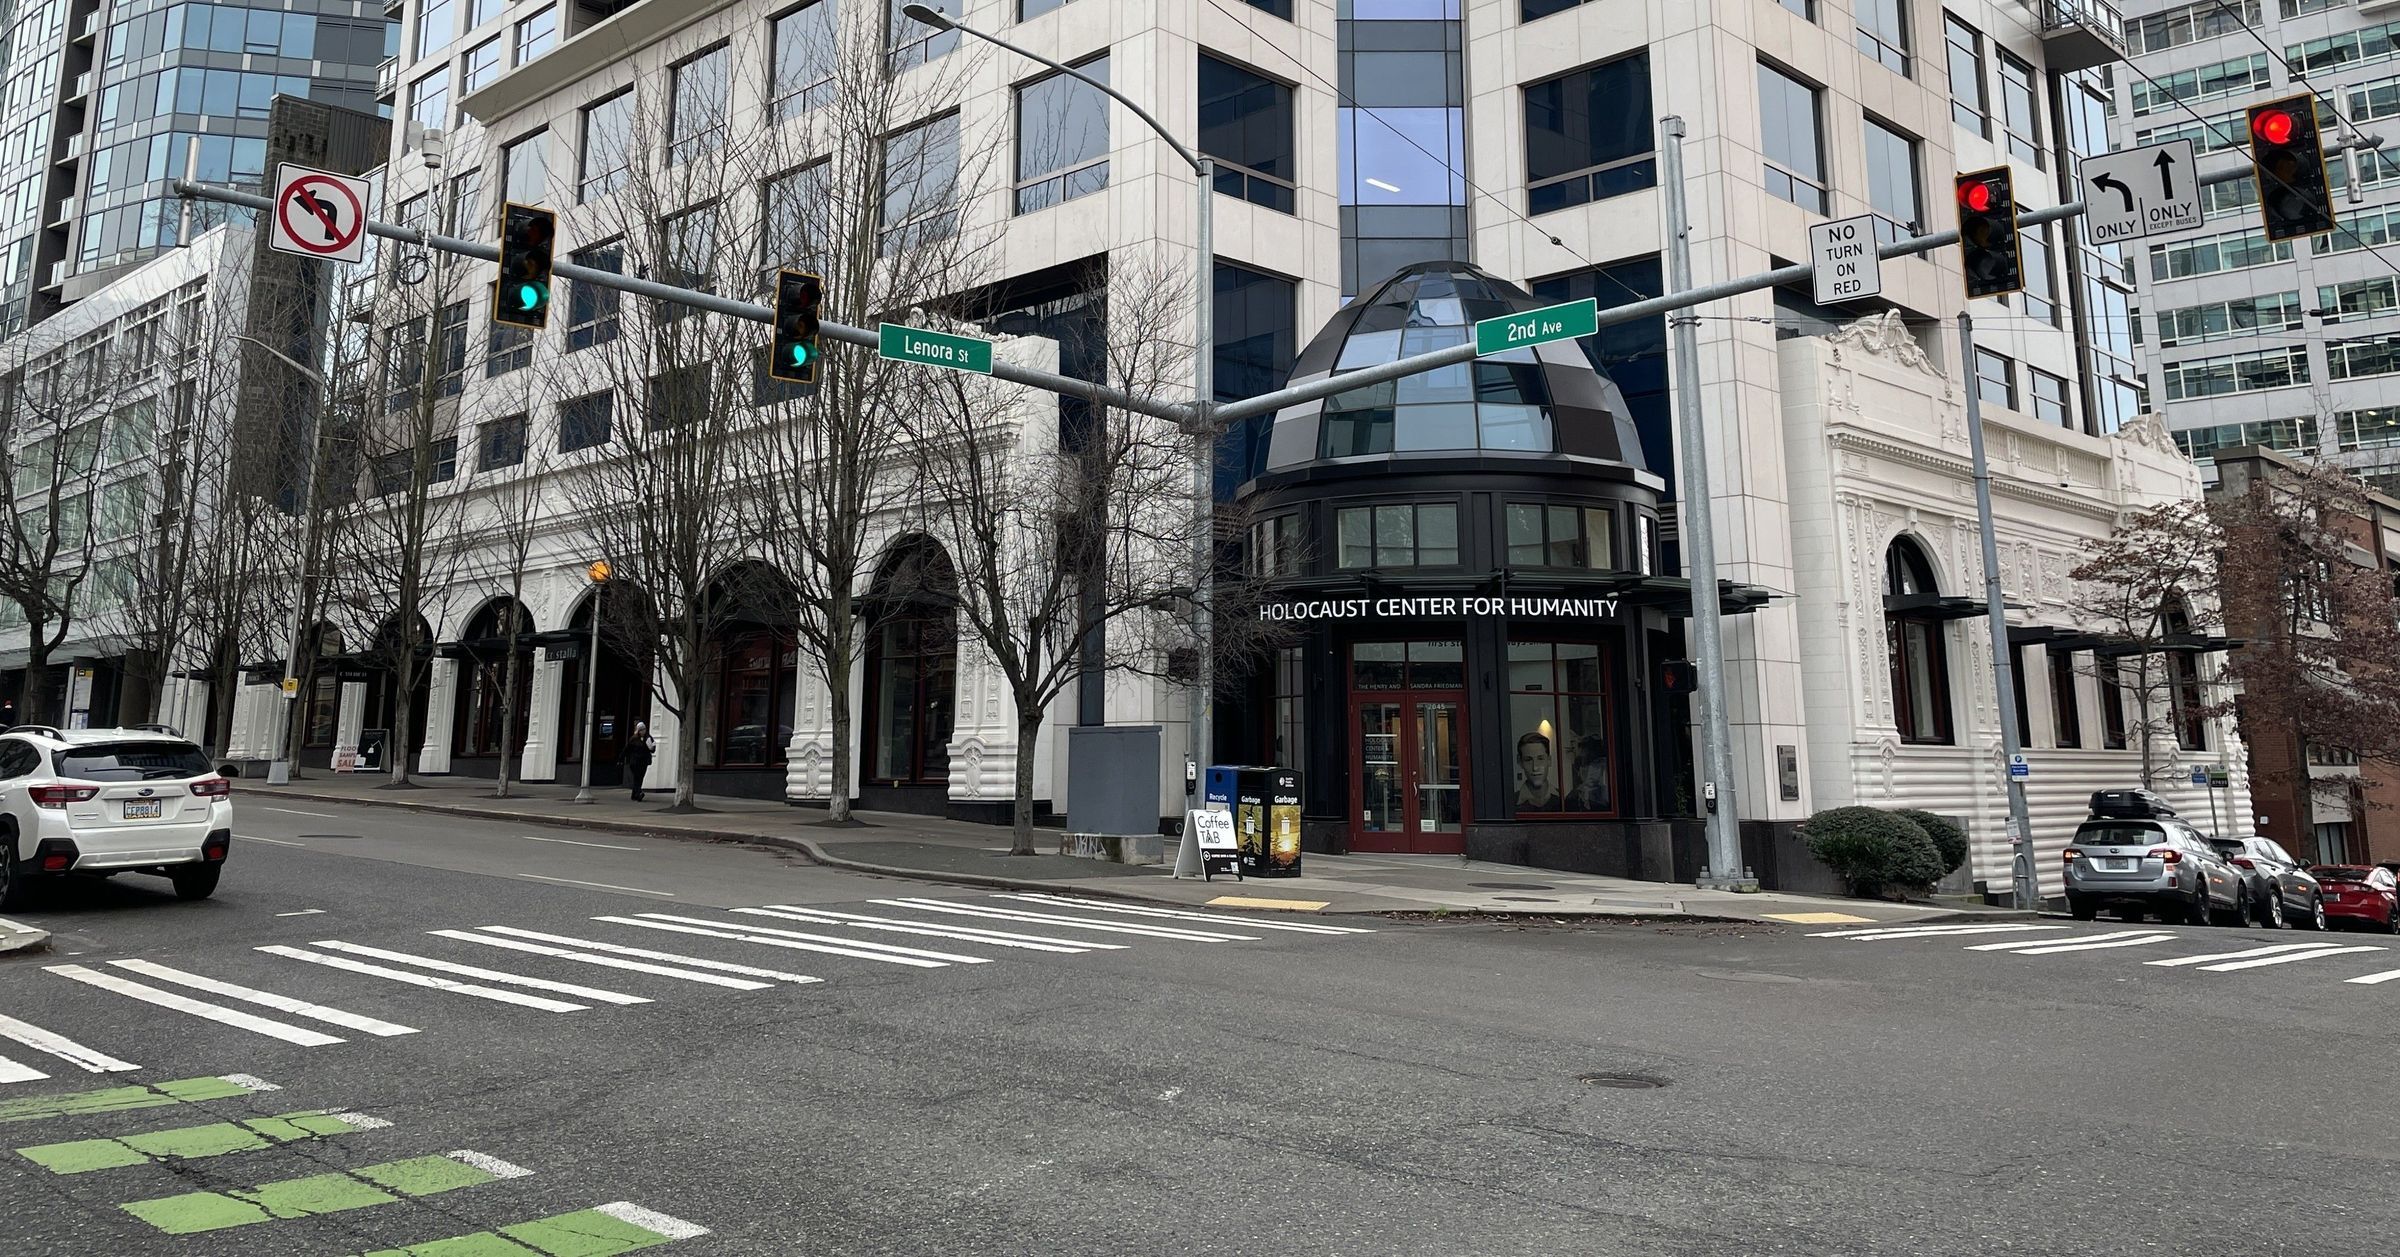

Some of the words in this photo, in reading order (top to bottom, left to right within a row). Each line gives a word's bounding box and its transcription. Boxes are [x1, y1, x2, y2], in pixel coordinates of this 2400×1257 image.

[2150, 202, 2192, 222] ONLY
[2096, 219, 2136, 239] ONLY
[2149, 220, 2173, 230] EXCEPT
[2176, 216, 2197, 226] BUSES
[1828, 225, 1855, 243] NO
[1826, 243, 1863, 261] TURN
[1837, 262, 1855, 276] ON
[1834, 279, 1861, 295] RED
[1507, 319, 1536, 342] 2nd
[1542, 321, 1562, 335] Ave
[905, 335, 953, 360] Lenora
[958, 349, 969, 363] St
[1259, 599, 1370, 621] HOLOCAUST
[1376, 598, 1457, 616] CENTER
[1462, 597, 1506, 616] FOR
[1511, 598, 1618, 617] HUMANITY
[1209, 793, 1228, 802] Recycle
[1241, 796, 1261, 804] Garbage
[1274, 795, 1298, 805] Garbage
[1198, 815, 1230, 829] Coffee
[1200, 829, 1221, 844] TAB
